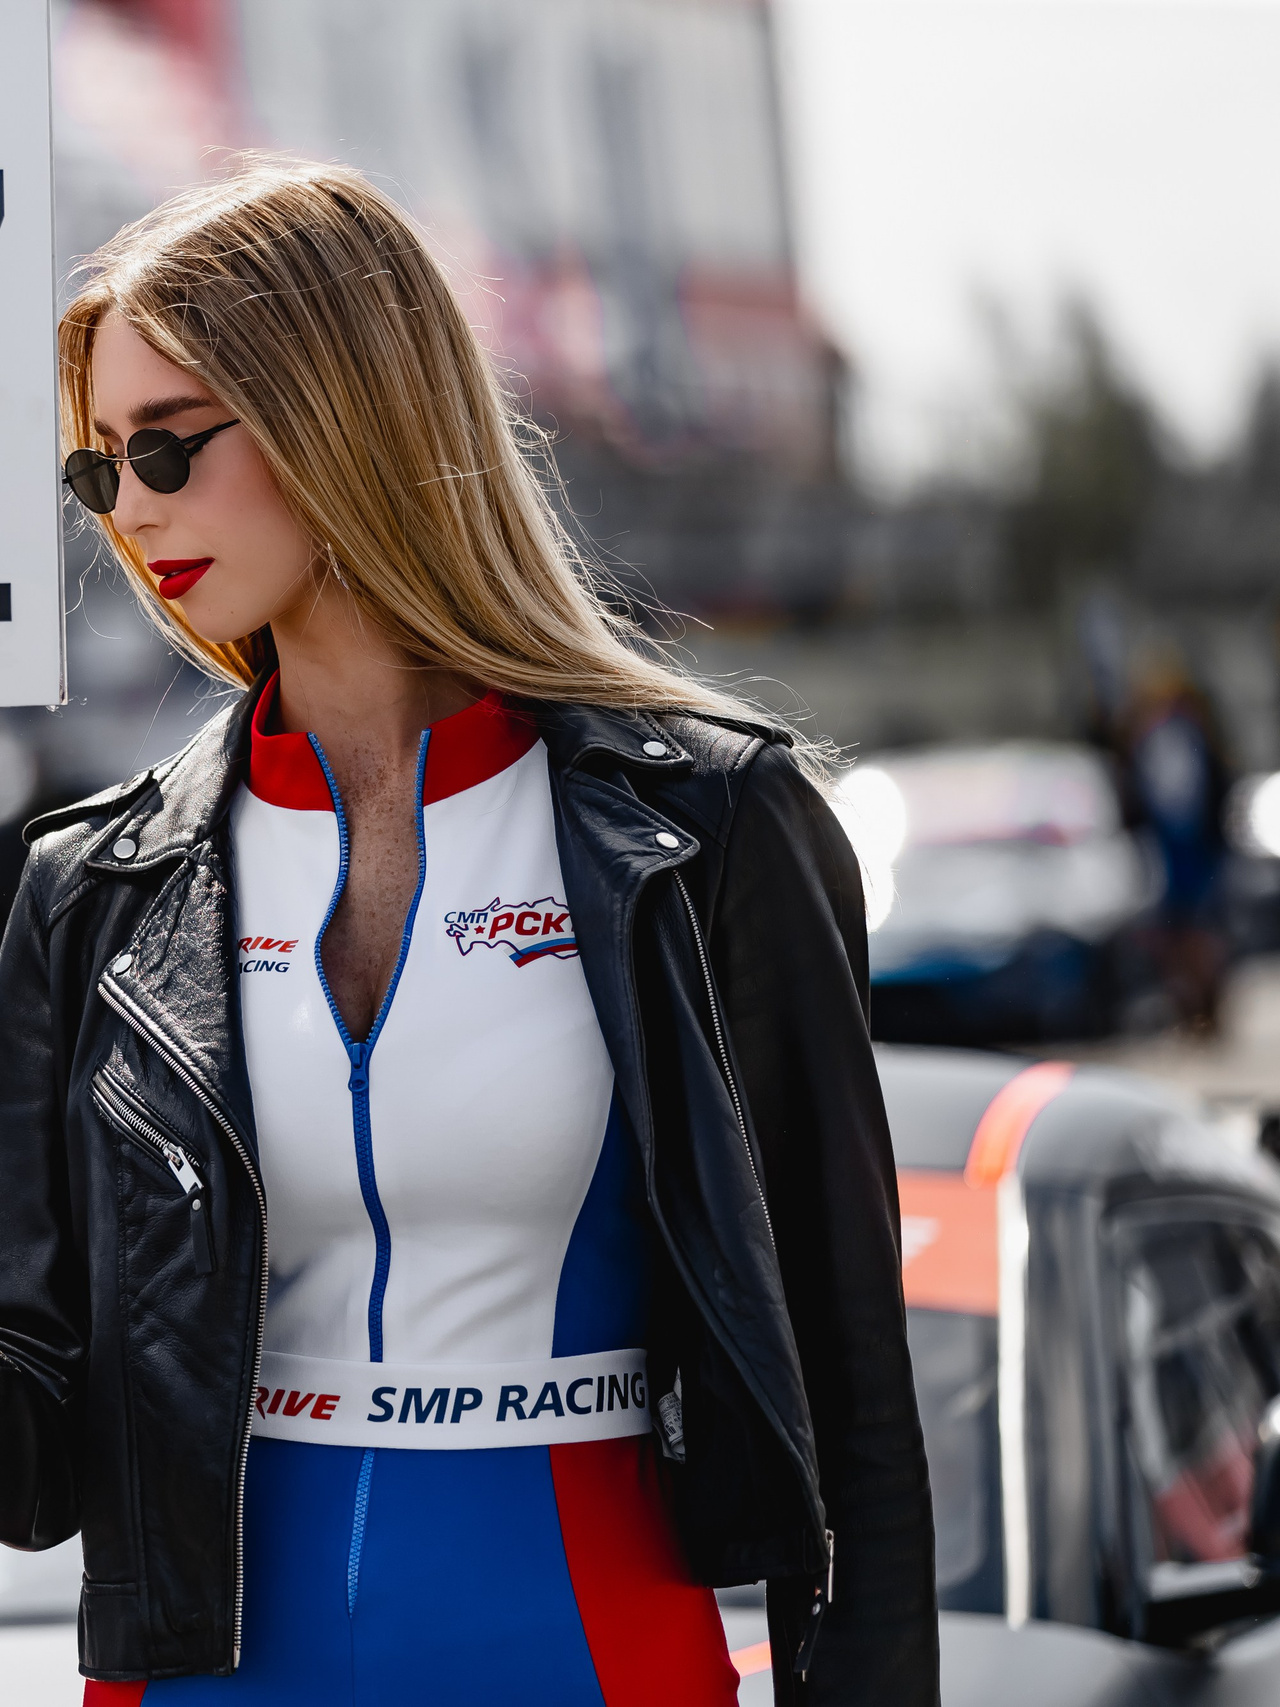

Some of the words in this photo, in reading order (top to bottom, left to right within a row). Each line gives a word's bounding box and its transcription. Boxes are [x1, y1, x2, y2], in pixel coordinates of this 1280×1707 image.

[444, 911, 488, 924] СМП
[488, 911, 575, 940] РСК
[240, 959, 290, 974] CING
[367, 1386, 483, 1424] SMP
[496, 1372, 646, 1422] RACING
